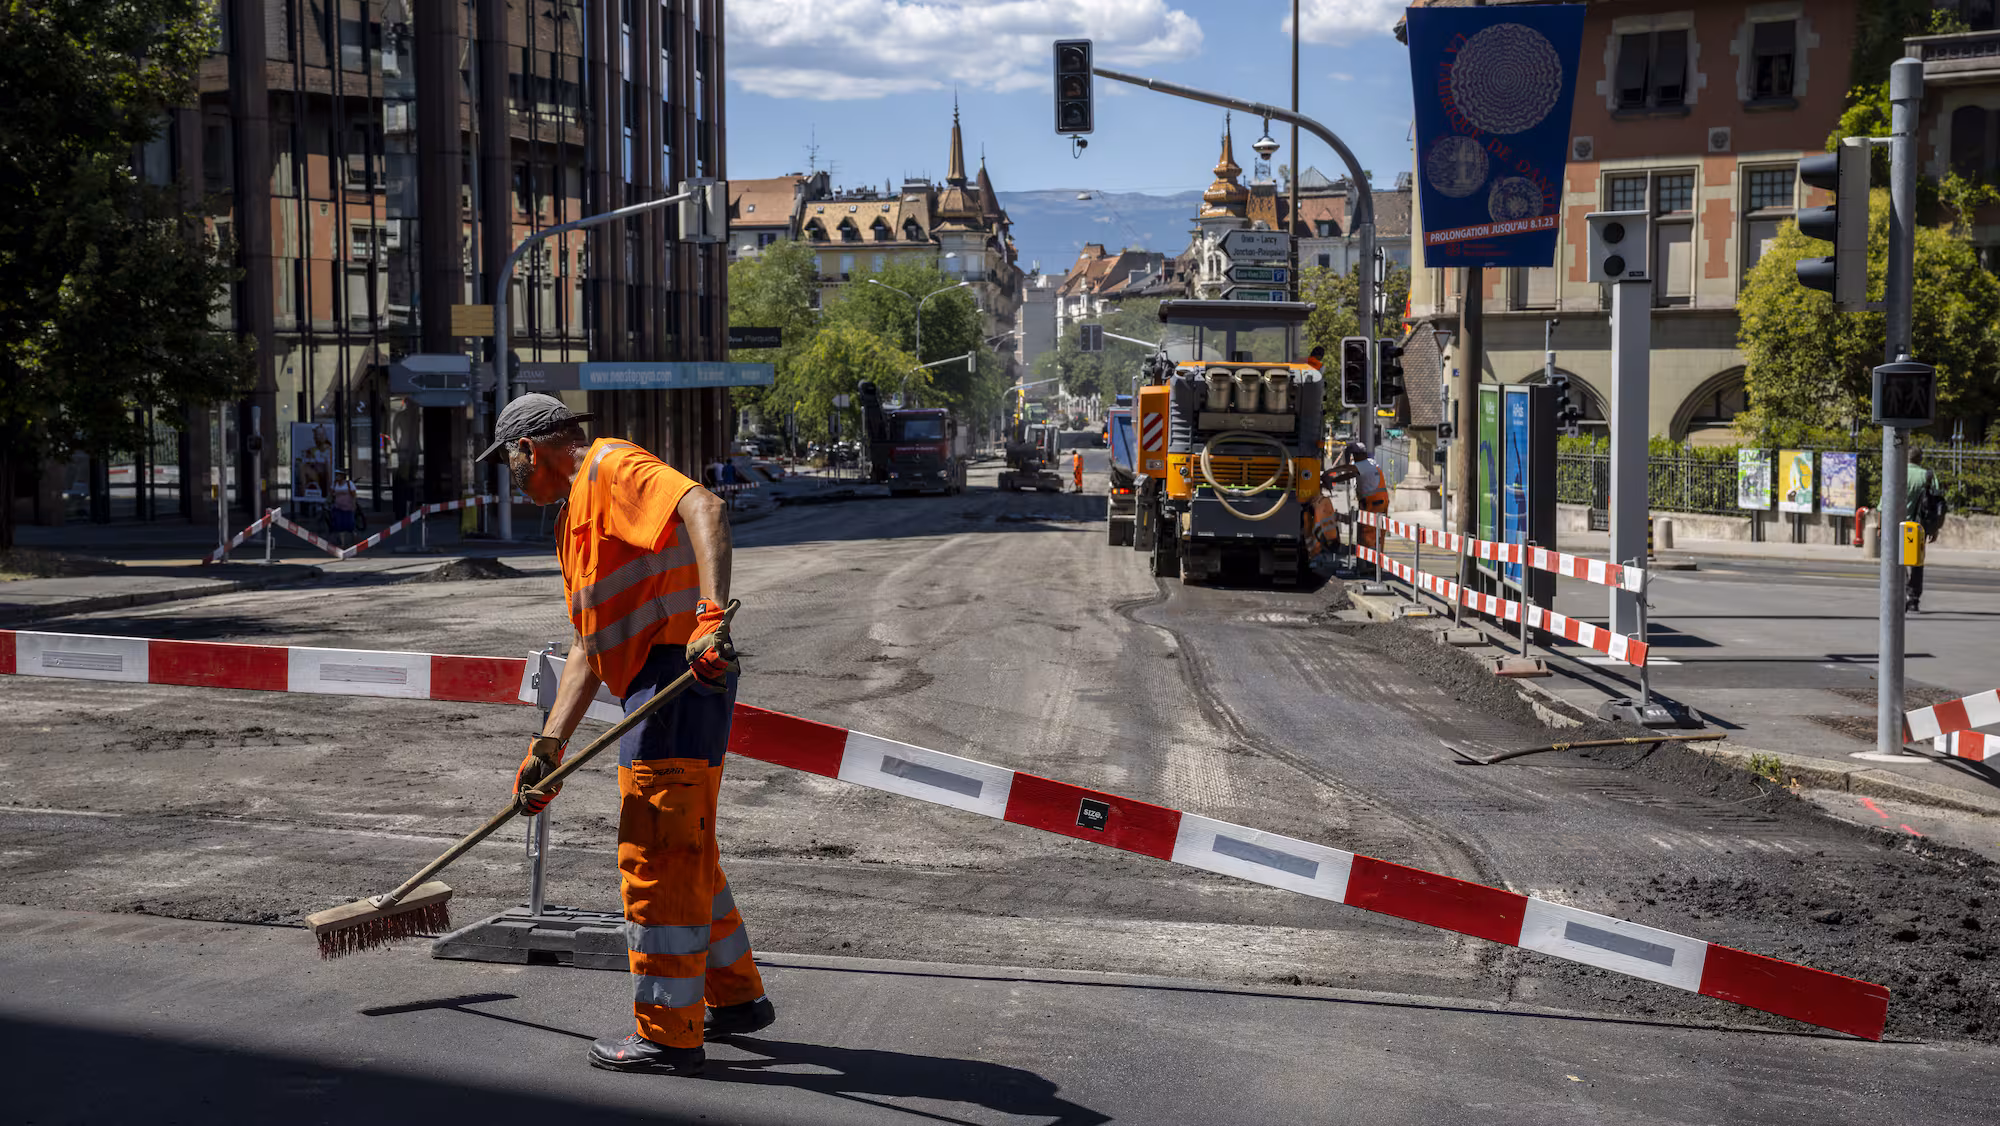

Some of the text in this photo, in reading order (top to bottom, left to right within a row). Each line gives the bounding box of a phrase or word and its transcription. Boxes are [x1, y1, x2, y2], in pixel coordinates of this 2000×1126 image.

[1430, 217, 1554, 243] PROLONGATION JUSQU'AU 8.1.23
[1261, 235, 1278, 246] Lancy
